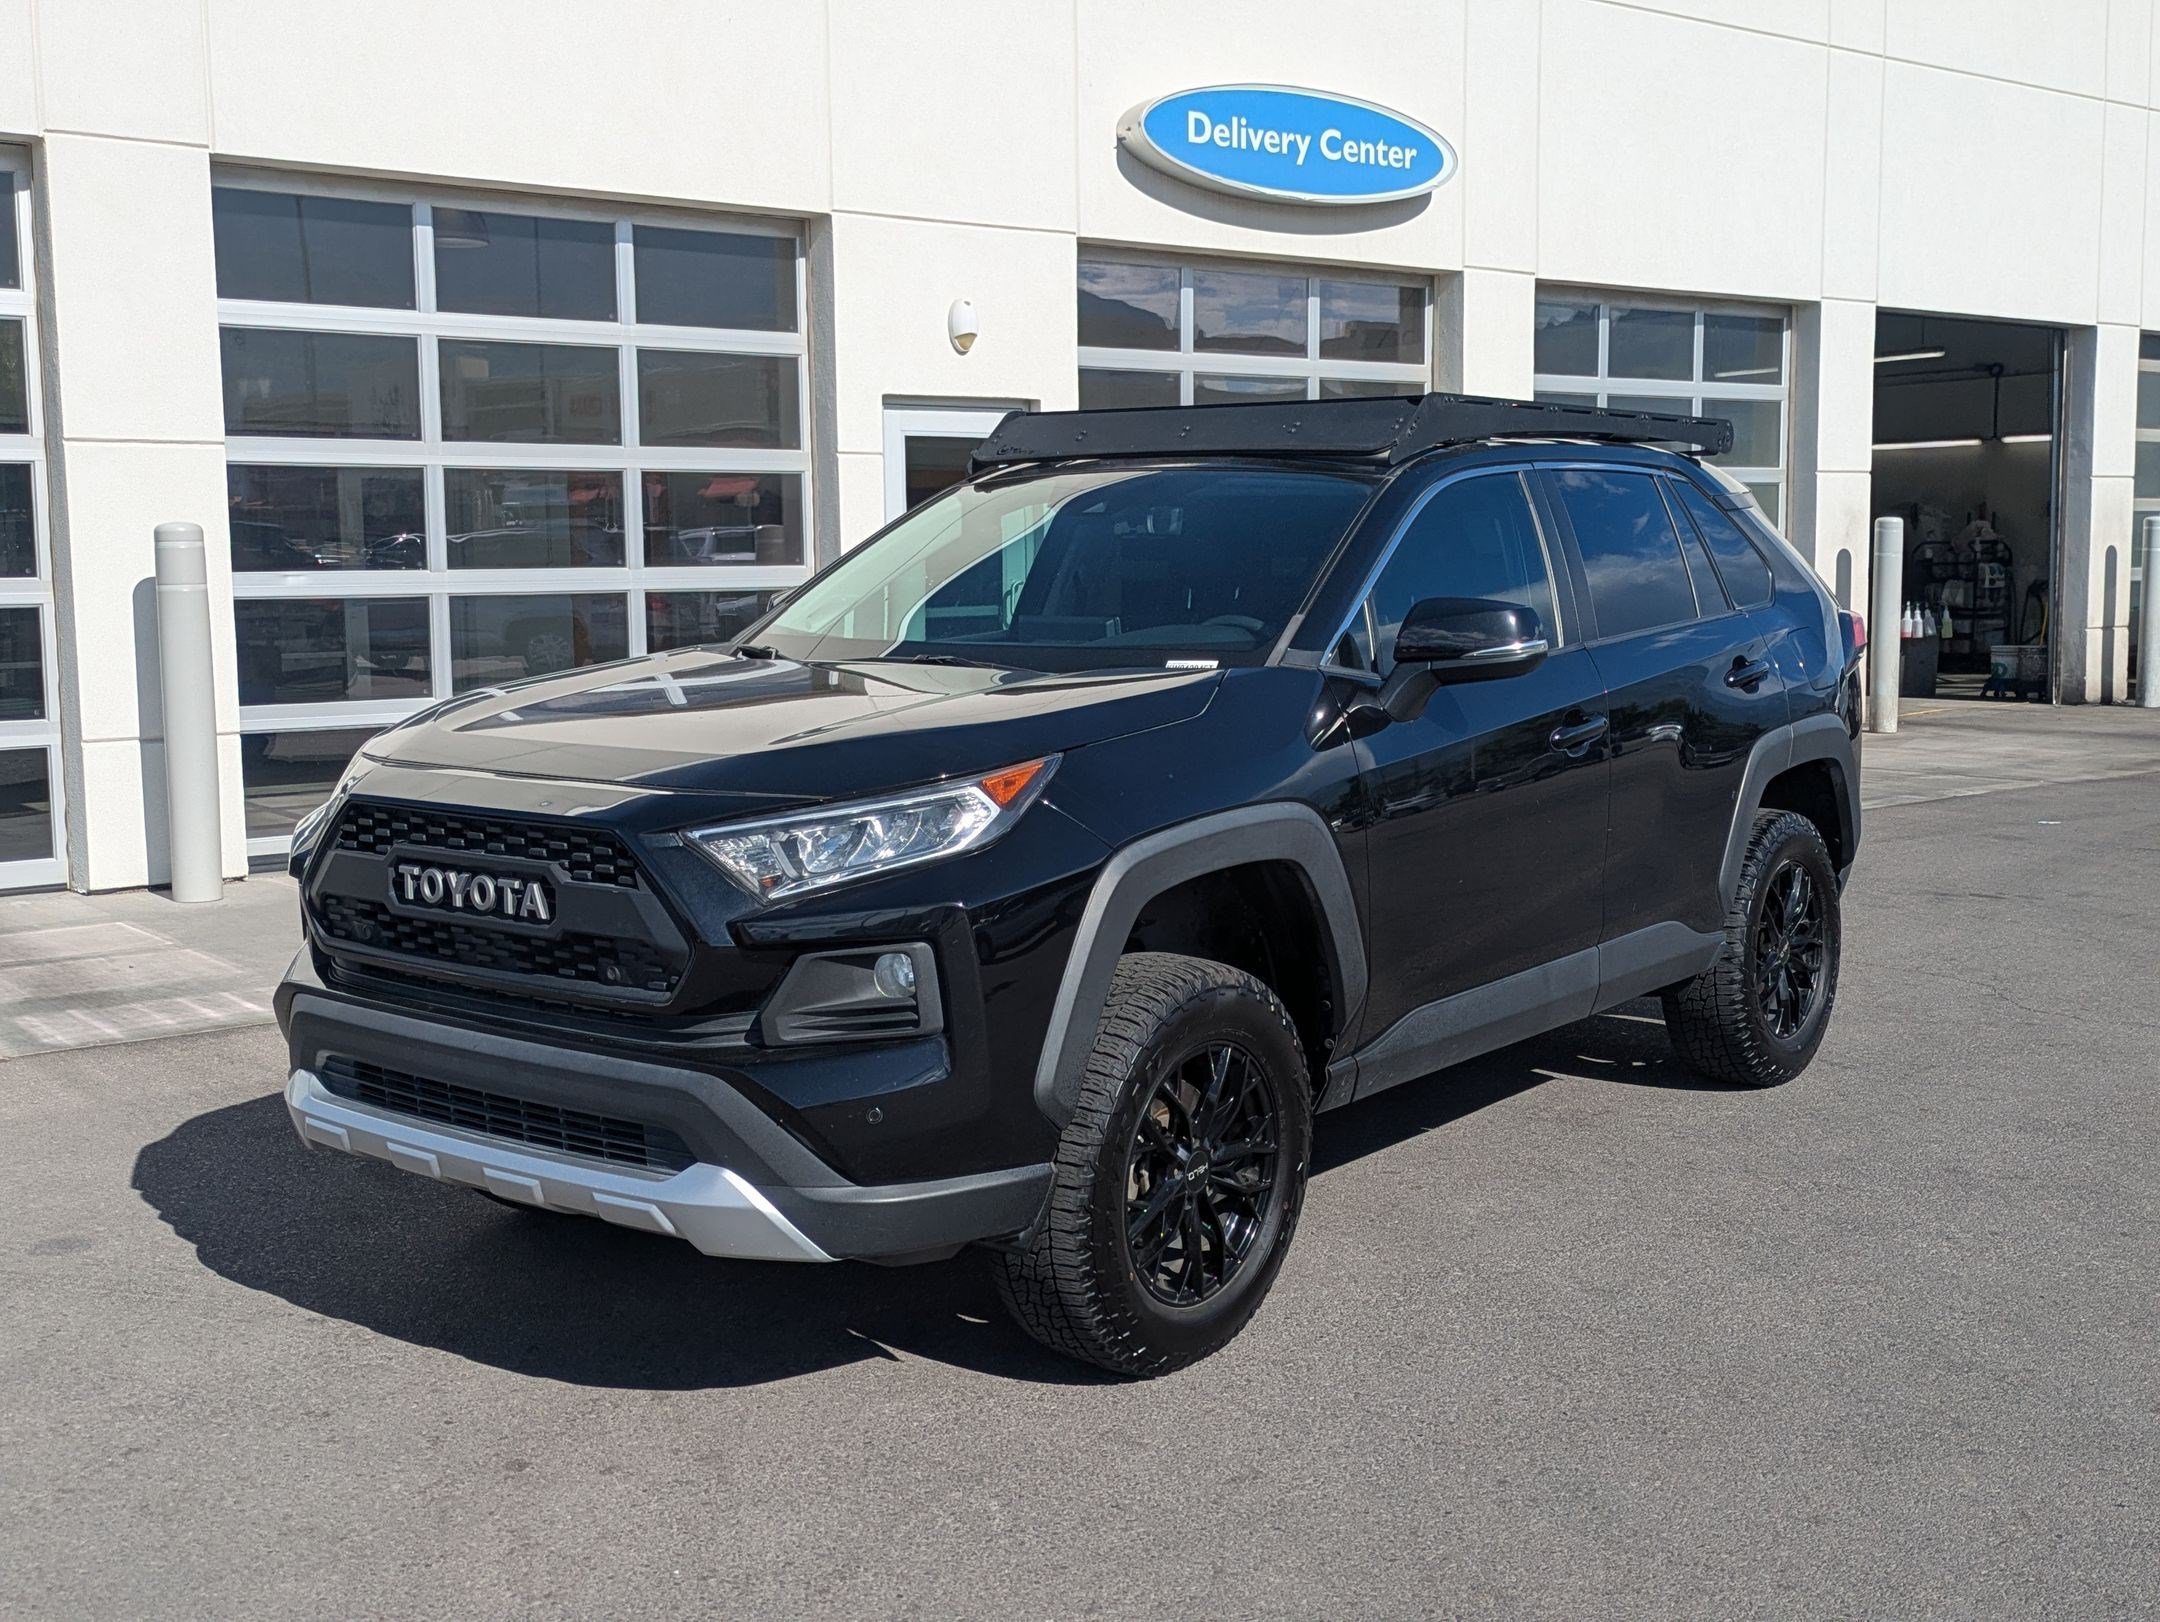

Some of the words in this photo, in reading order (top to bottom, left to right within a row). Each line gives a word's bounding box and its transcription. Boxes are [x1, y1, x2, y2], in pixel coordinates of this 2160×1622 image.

[1187, 110, 1311, 166] Delivery
[1320, 128, 1418, 170] Center
[398, 863, 550, 921] TOYOTA
